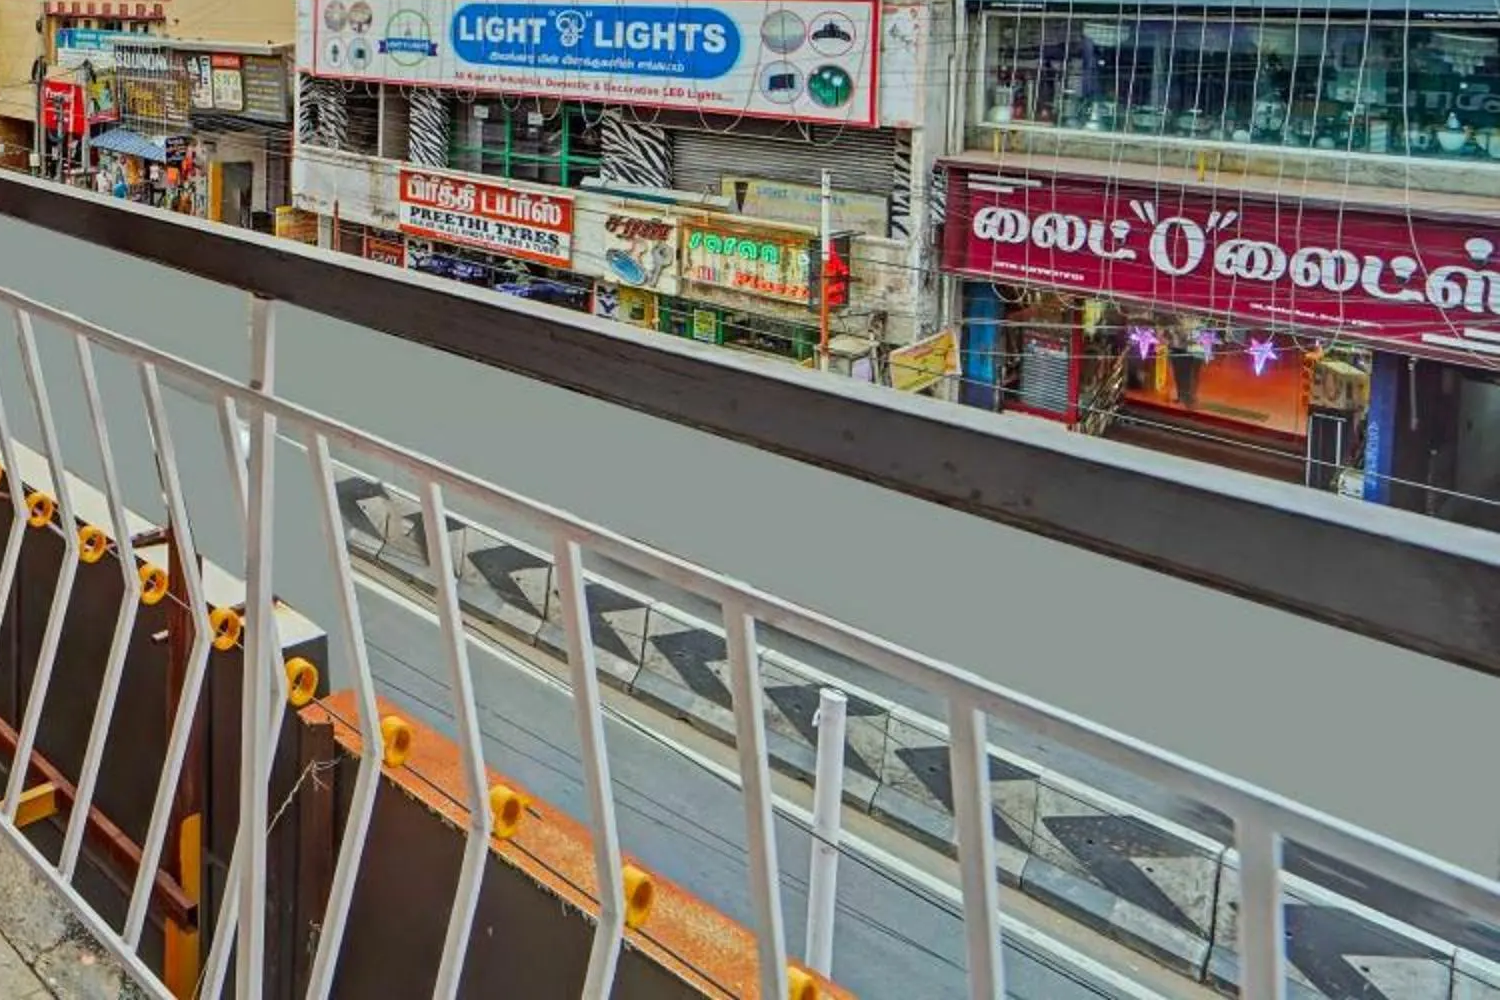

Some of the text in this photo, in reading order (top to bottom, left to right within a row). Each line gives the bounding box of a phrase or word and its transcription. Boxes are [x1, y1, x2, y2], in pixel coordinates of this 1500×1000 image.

[459, 15, 728, 54] LIGHT LIGHTS
[410, 206, 489, 233] PREETHI
[495, 222, 560, 247] TYRES
